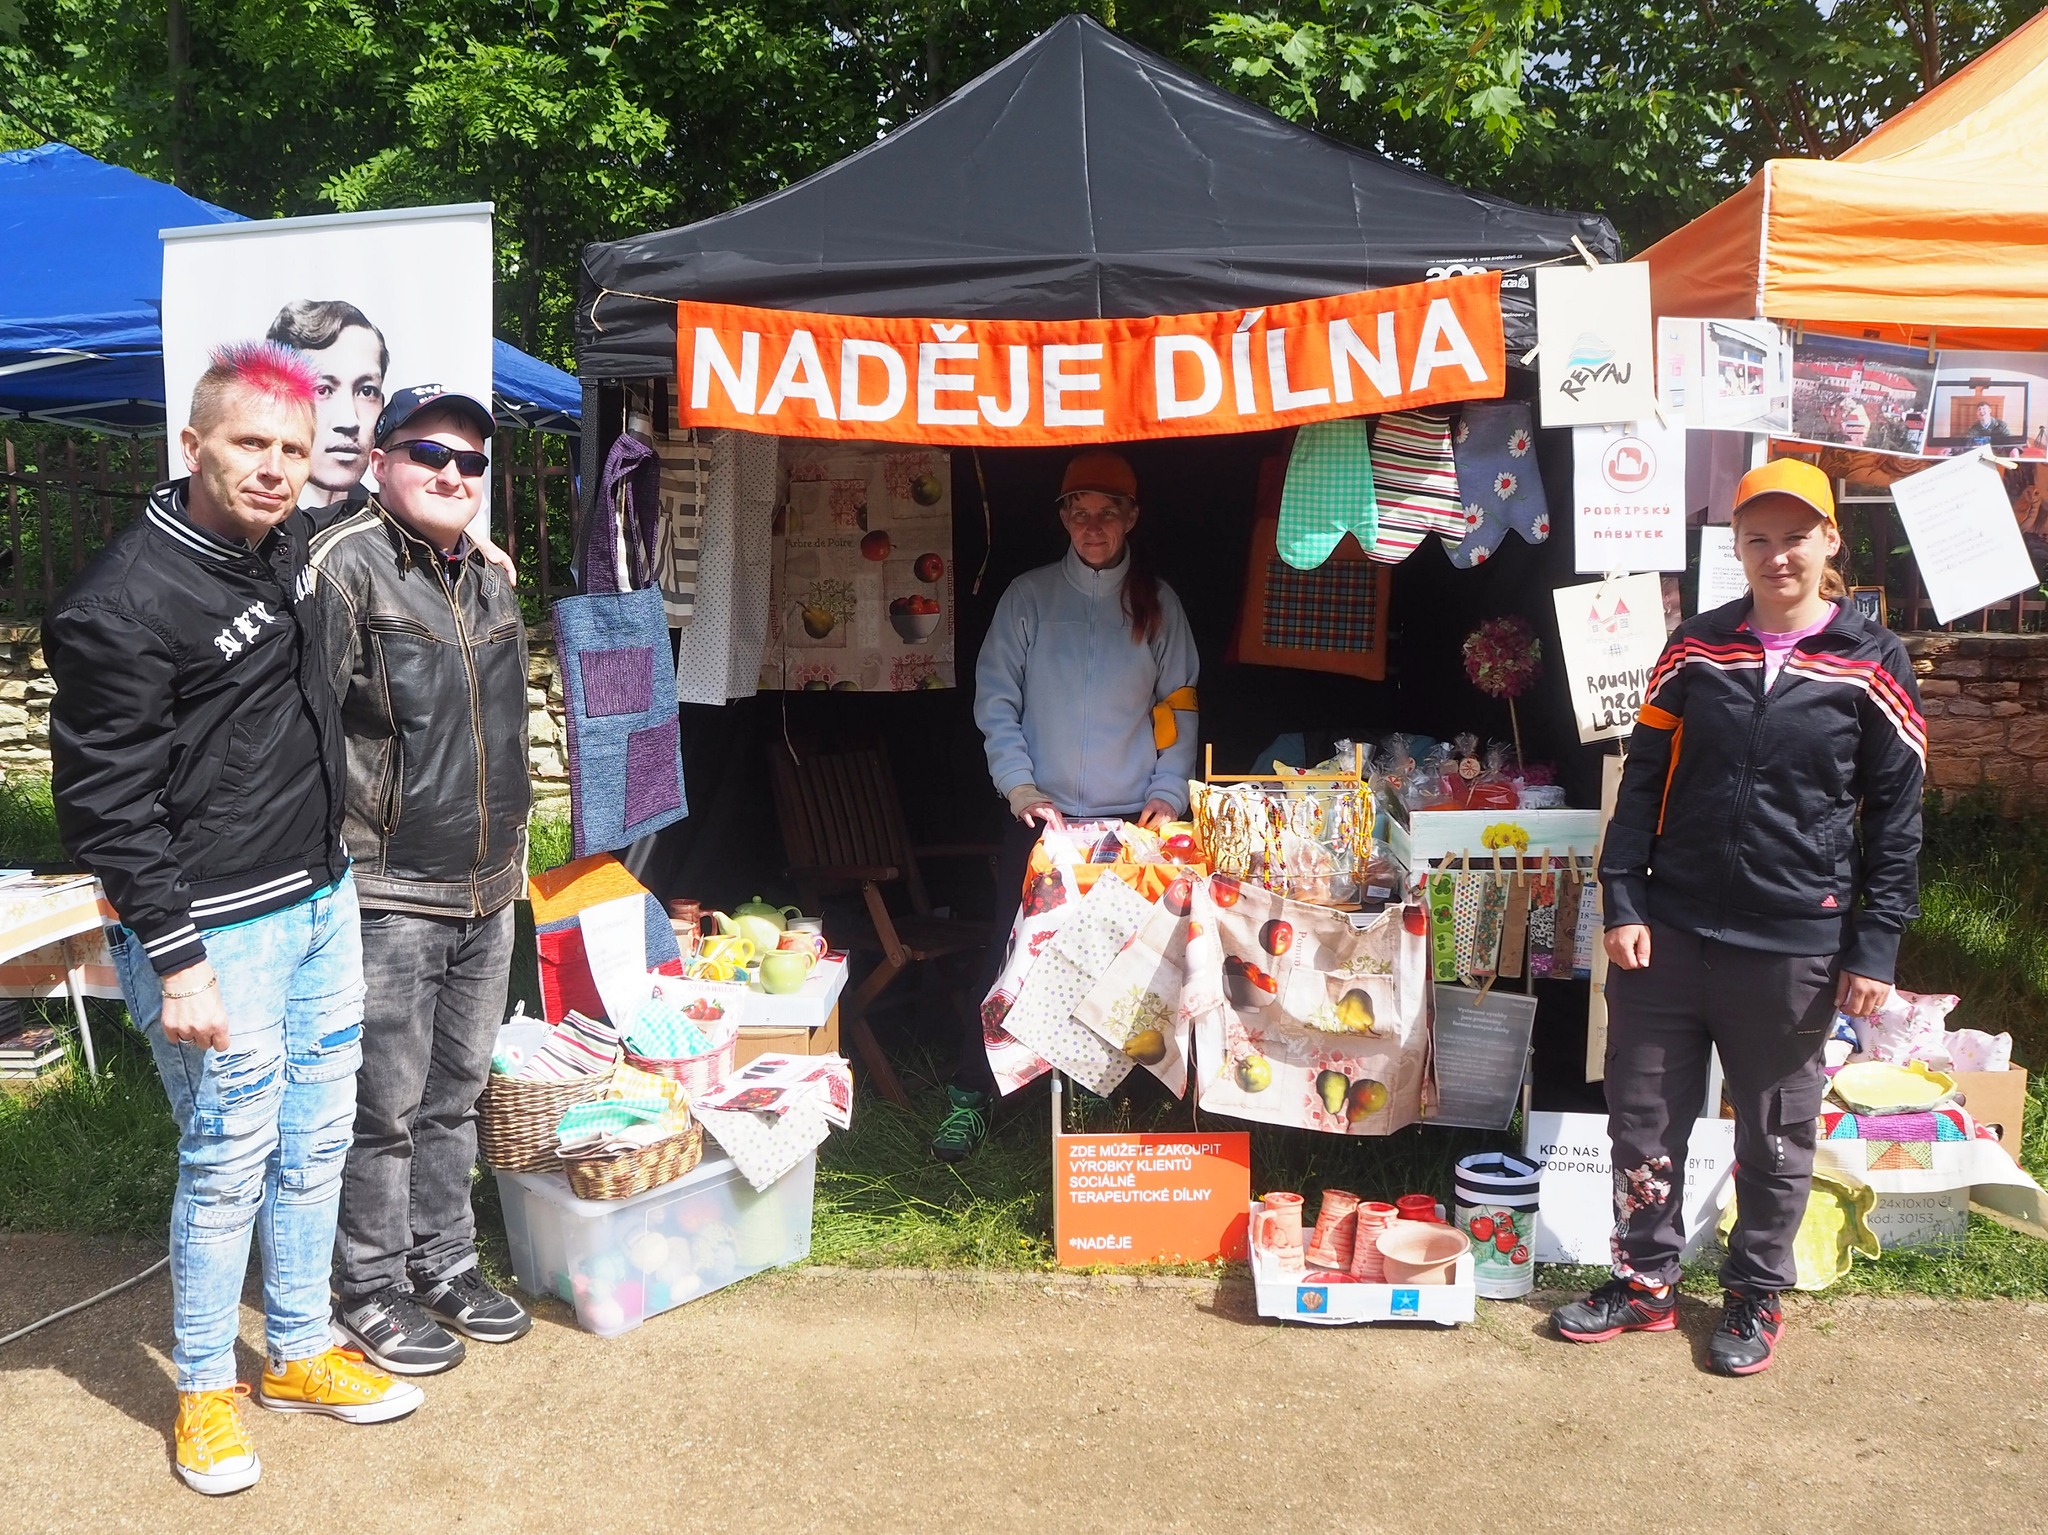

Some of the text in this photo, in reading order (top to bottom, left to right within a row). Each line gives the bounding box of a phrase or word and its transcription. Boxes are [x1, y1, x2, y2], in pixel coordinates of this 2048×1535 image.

[691, 298, 1488, 427] NADĚJE DÍLNA
[1583, 503, 1670, 515] PODŘIPSKÝ
[1594, 527, 1663, 539] NÁBYTEK
[814, 538, 826, 548] de
[1584, 888, 1593, 896] 16
[1582, 900, 1591, 908] 17
[1578, 923, 1587, 931] 19
[1070, 1143, 1221, 1157] ZDE MŮŽETE ZAKOUPIT
[1540, 1144, 1599, 1157] KDO NÁS
[1070, 1158, 1192, 1172] VÝROBKY KLIENTŮ
[1690, 1158, 1714, 1169] BY TO
[1070, 1173, 1135, 1188] SOCIÁLNĚ
[1070, 1188, 1211, 1203] TERAPEUTICKÉ DÍLNY
[1879, 1198, 1936, 1209] 24x10x10
[1867, 1213, 1934, 1225] kód: 30153
